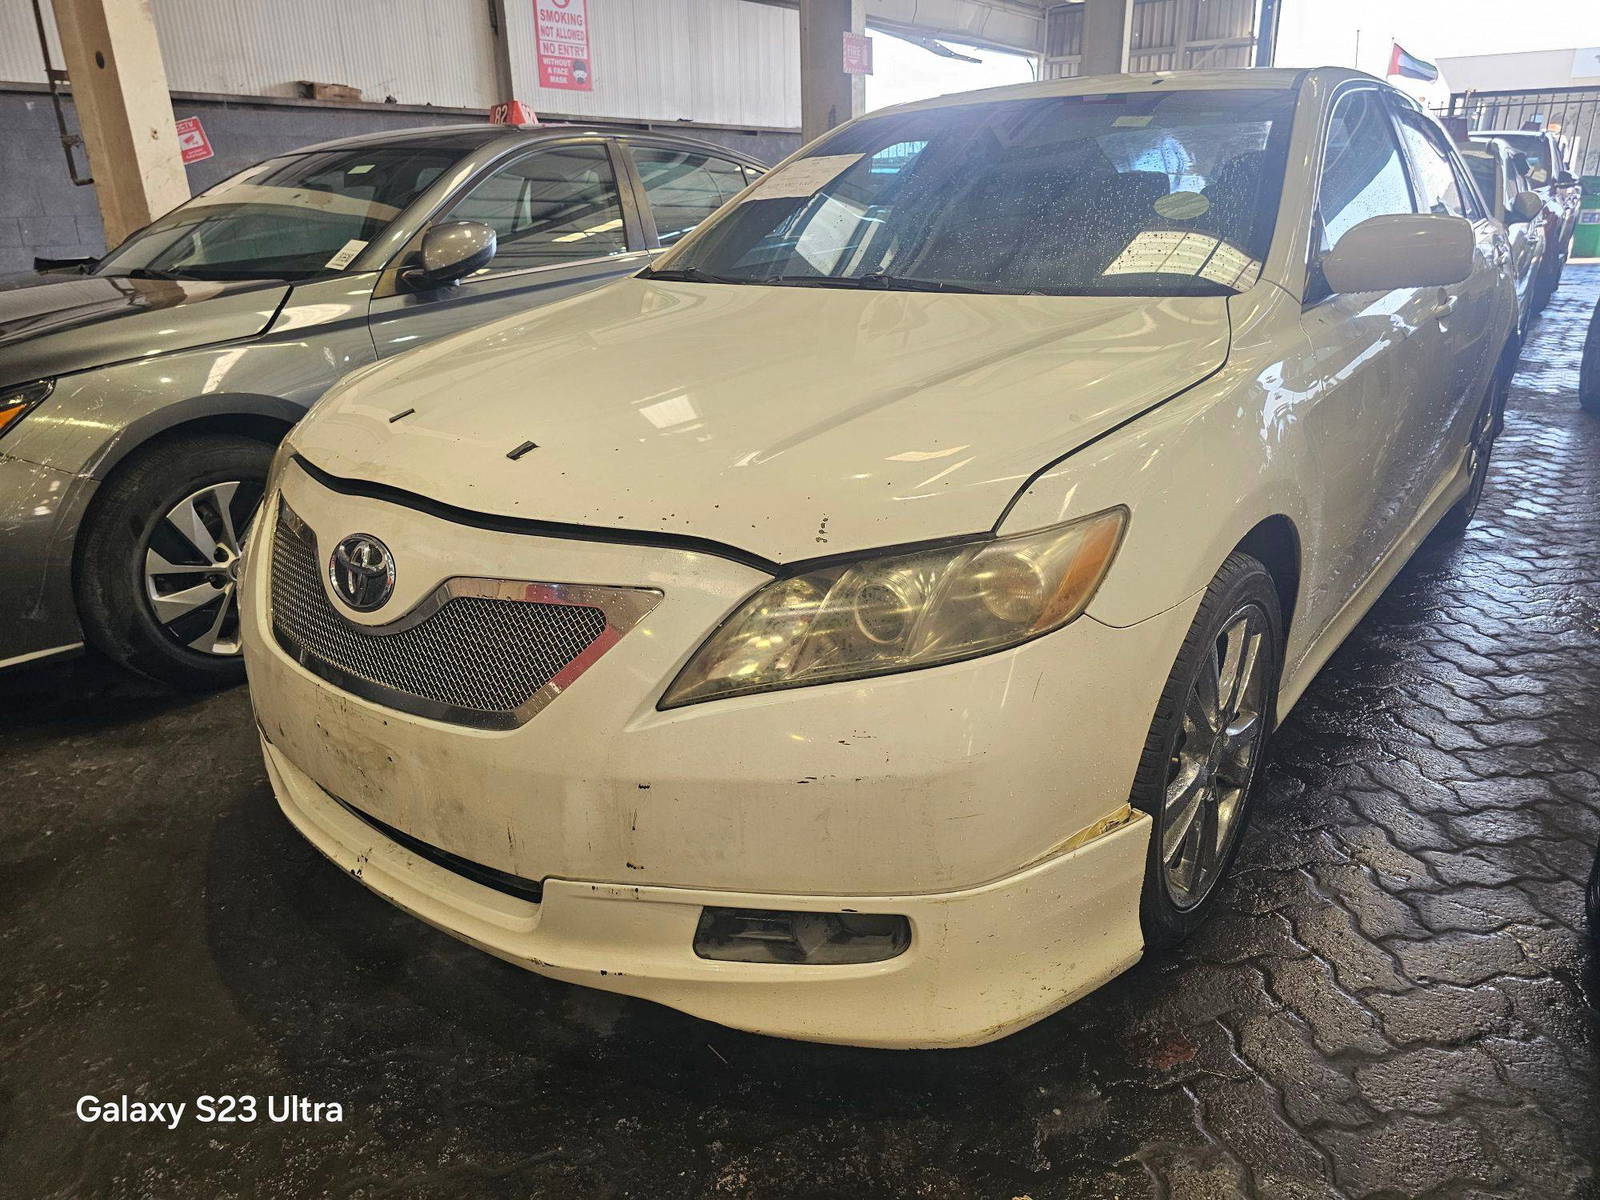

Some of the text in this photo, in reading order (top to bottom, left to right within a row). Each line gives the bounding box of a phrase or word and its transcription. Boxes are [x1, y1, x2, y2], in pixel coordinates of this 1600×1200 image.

[540, 9, 583, 26] SMOKING
[540, 25, 585, 41] NOT ALLOWED
[543, 42, 585, 57] NO ENTRY
[543, 57, 571, 68] WITHOUT
